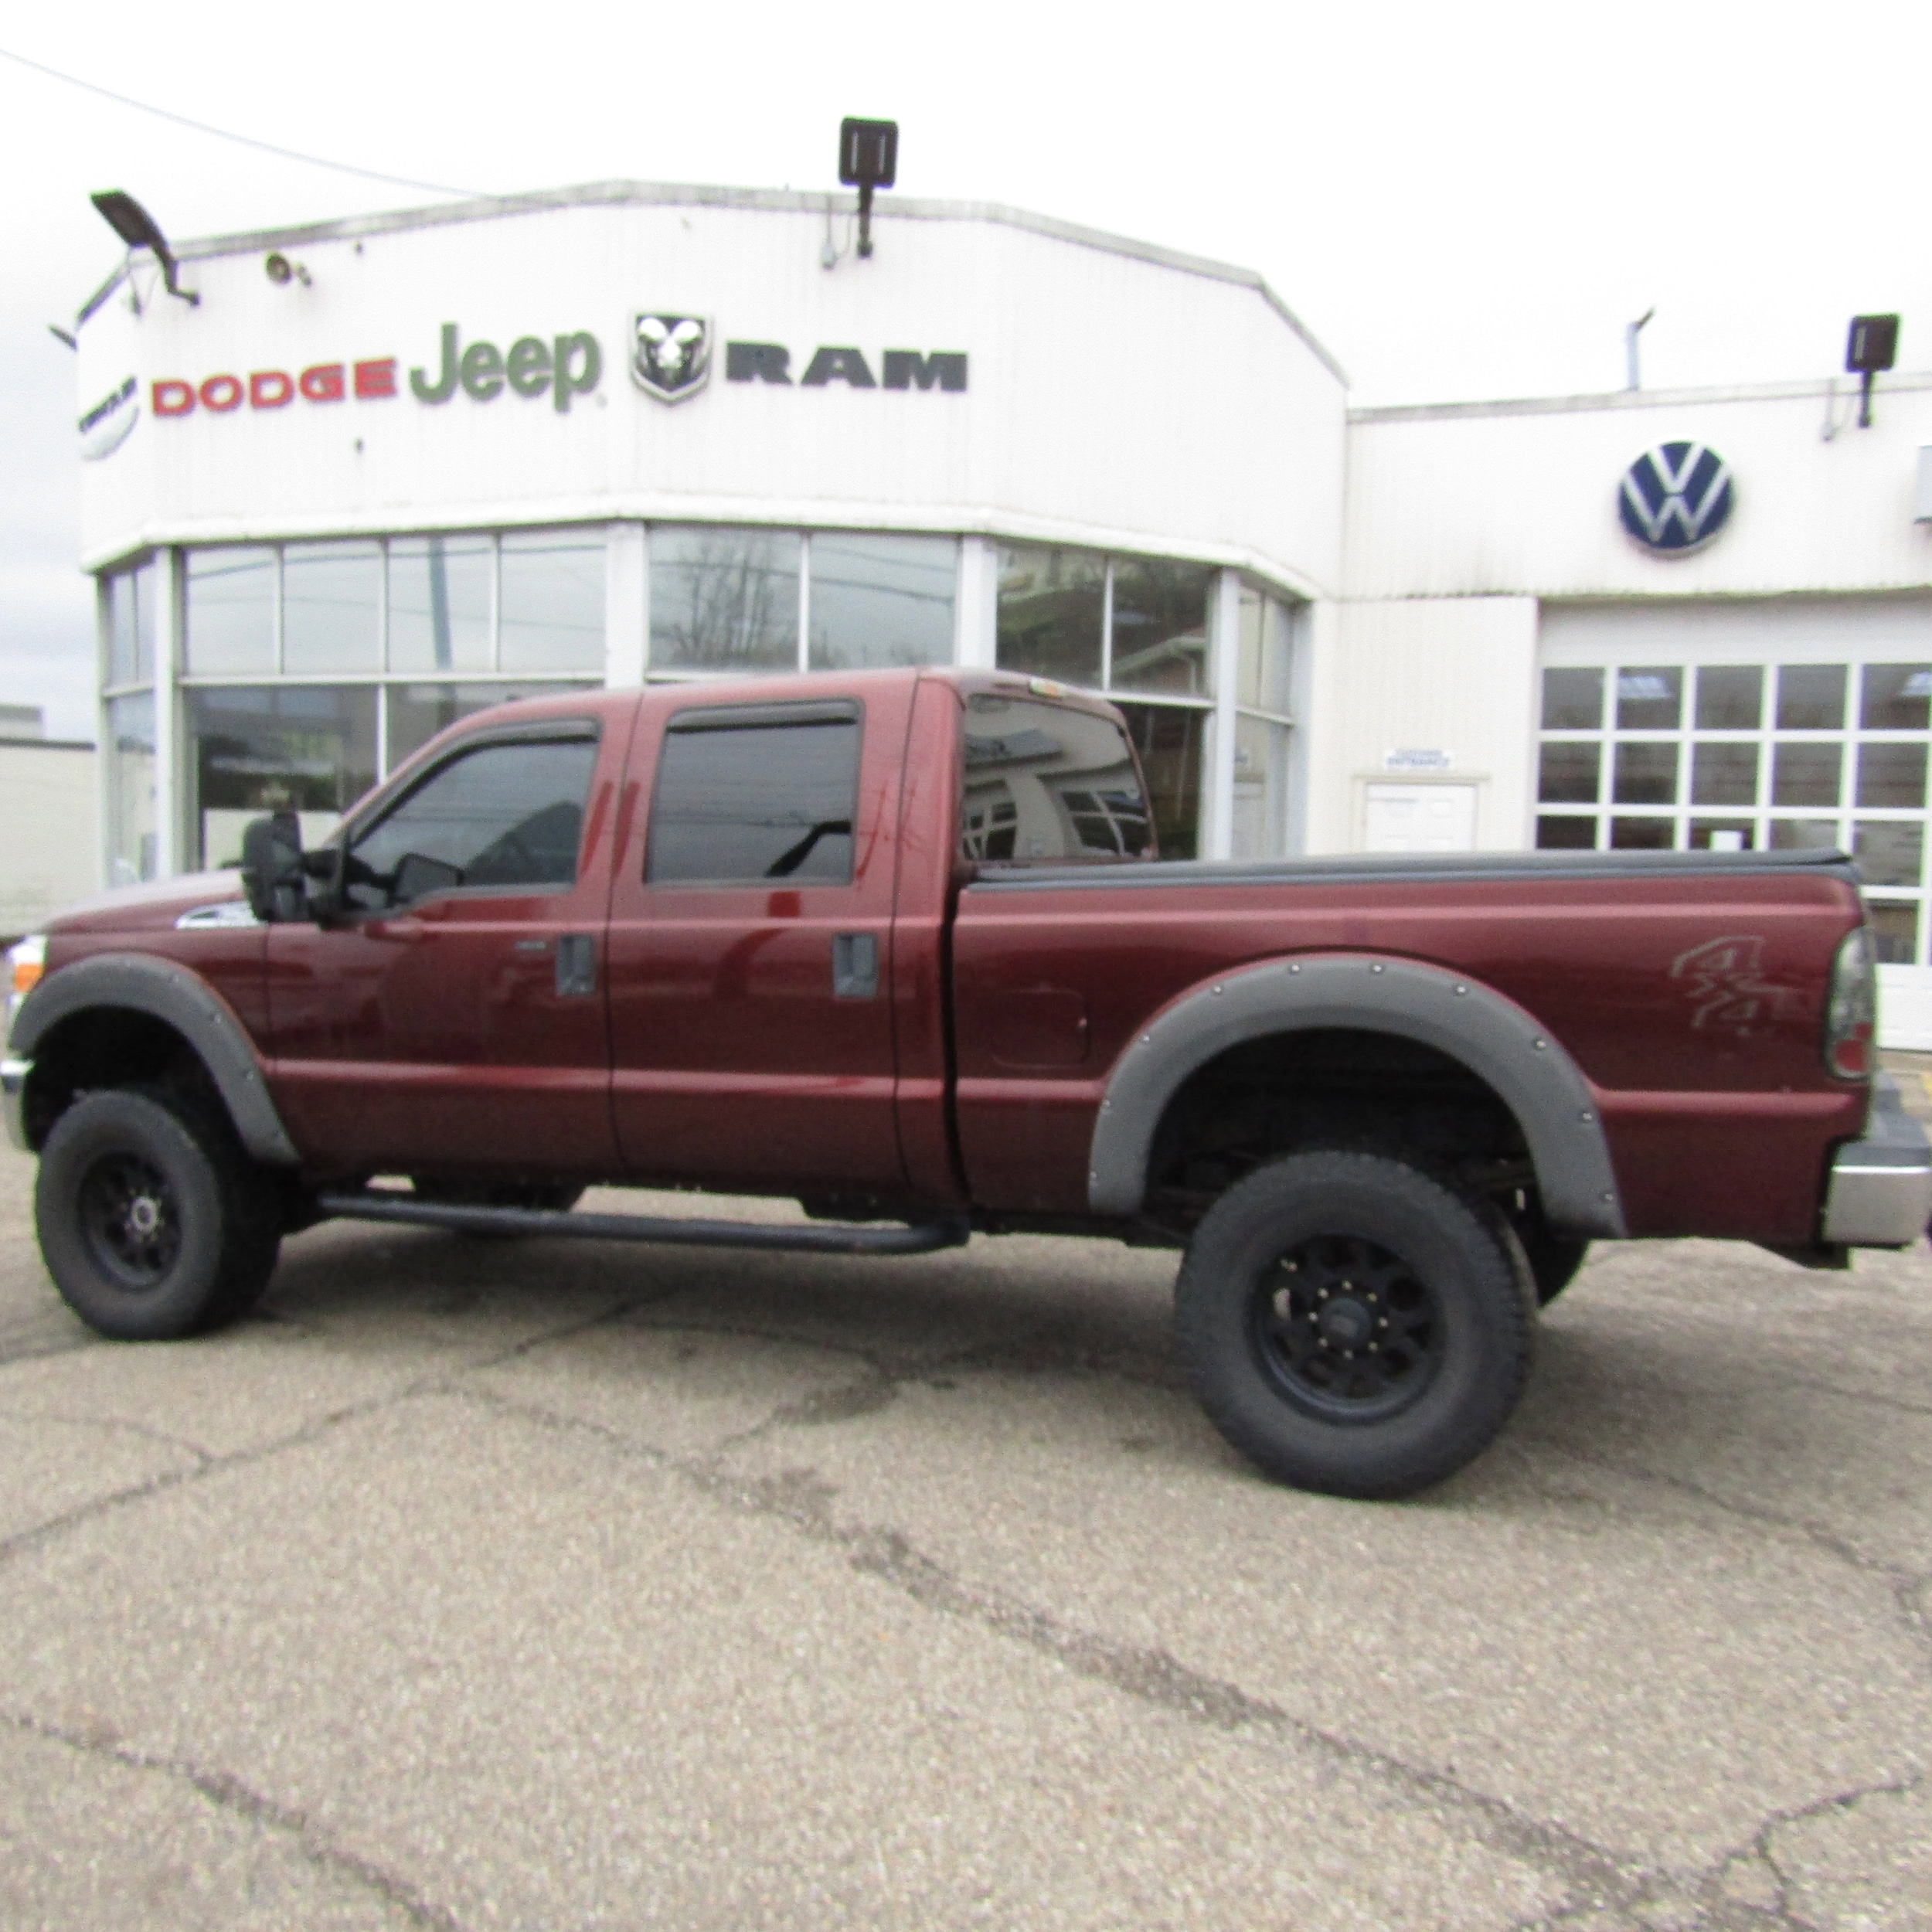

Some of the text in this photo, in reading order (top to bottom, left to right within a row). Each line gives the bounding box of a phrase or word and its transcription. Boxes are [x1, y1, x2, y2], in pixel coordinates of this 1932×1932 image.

[151, 357, 397, 418] DODGE
[410, 322, 601, 412] Jeep
[726, 341, 968, 393] RAM
